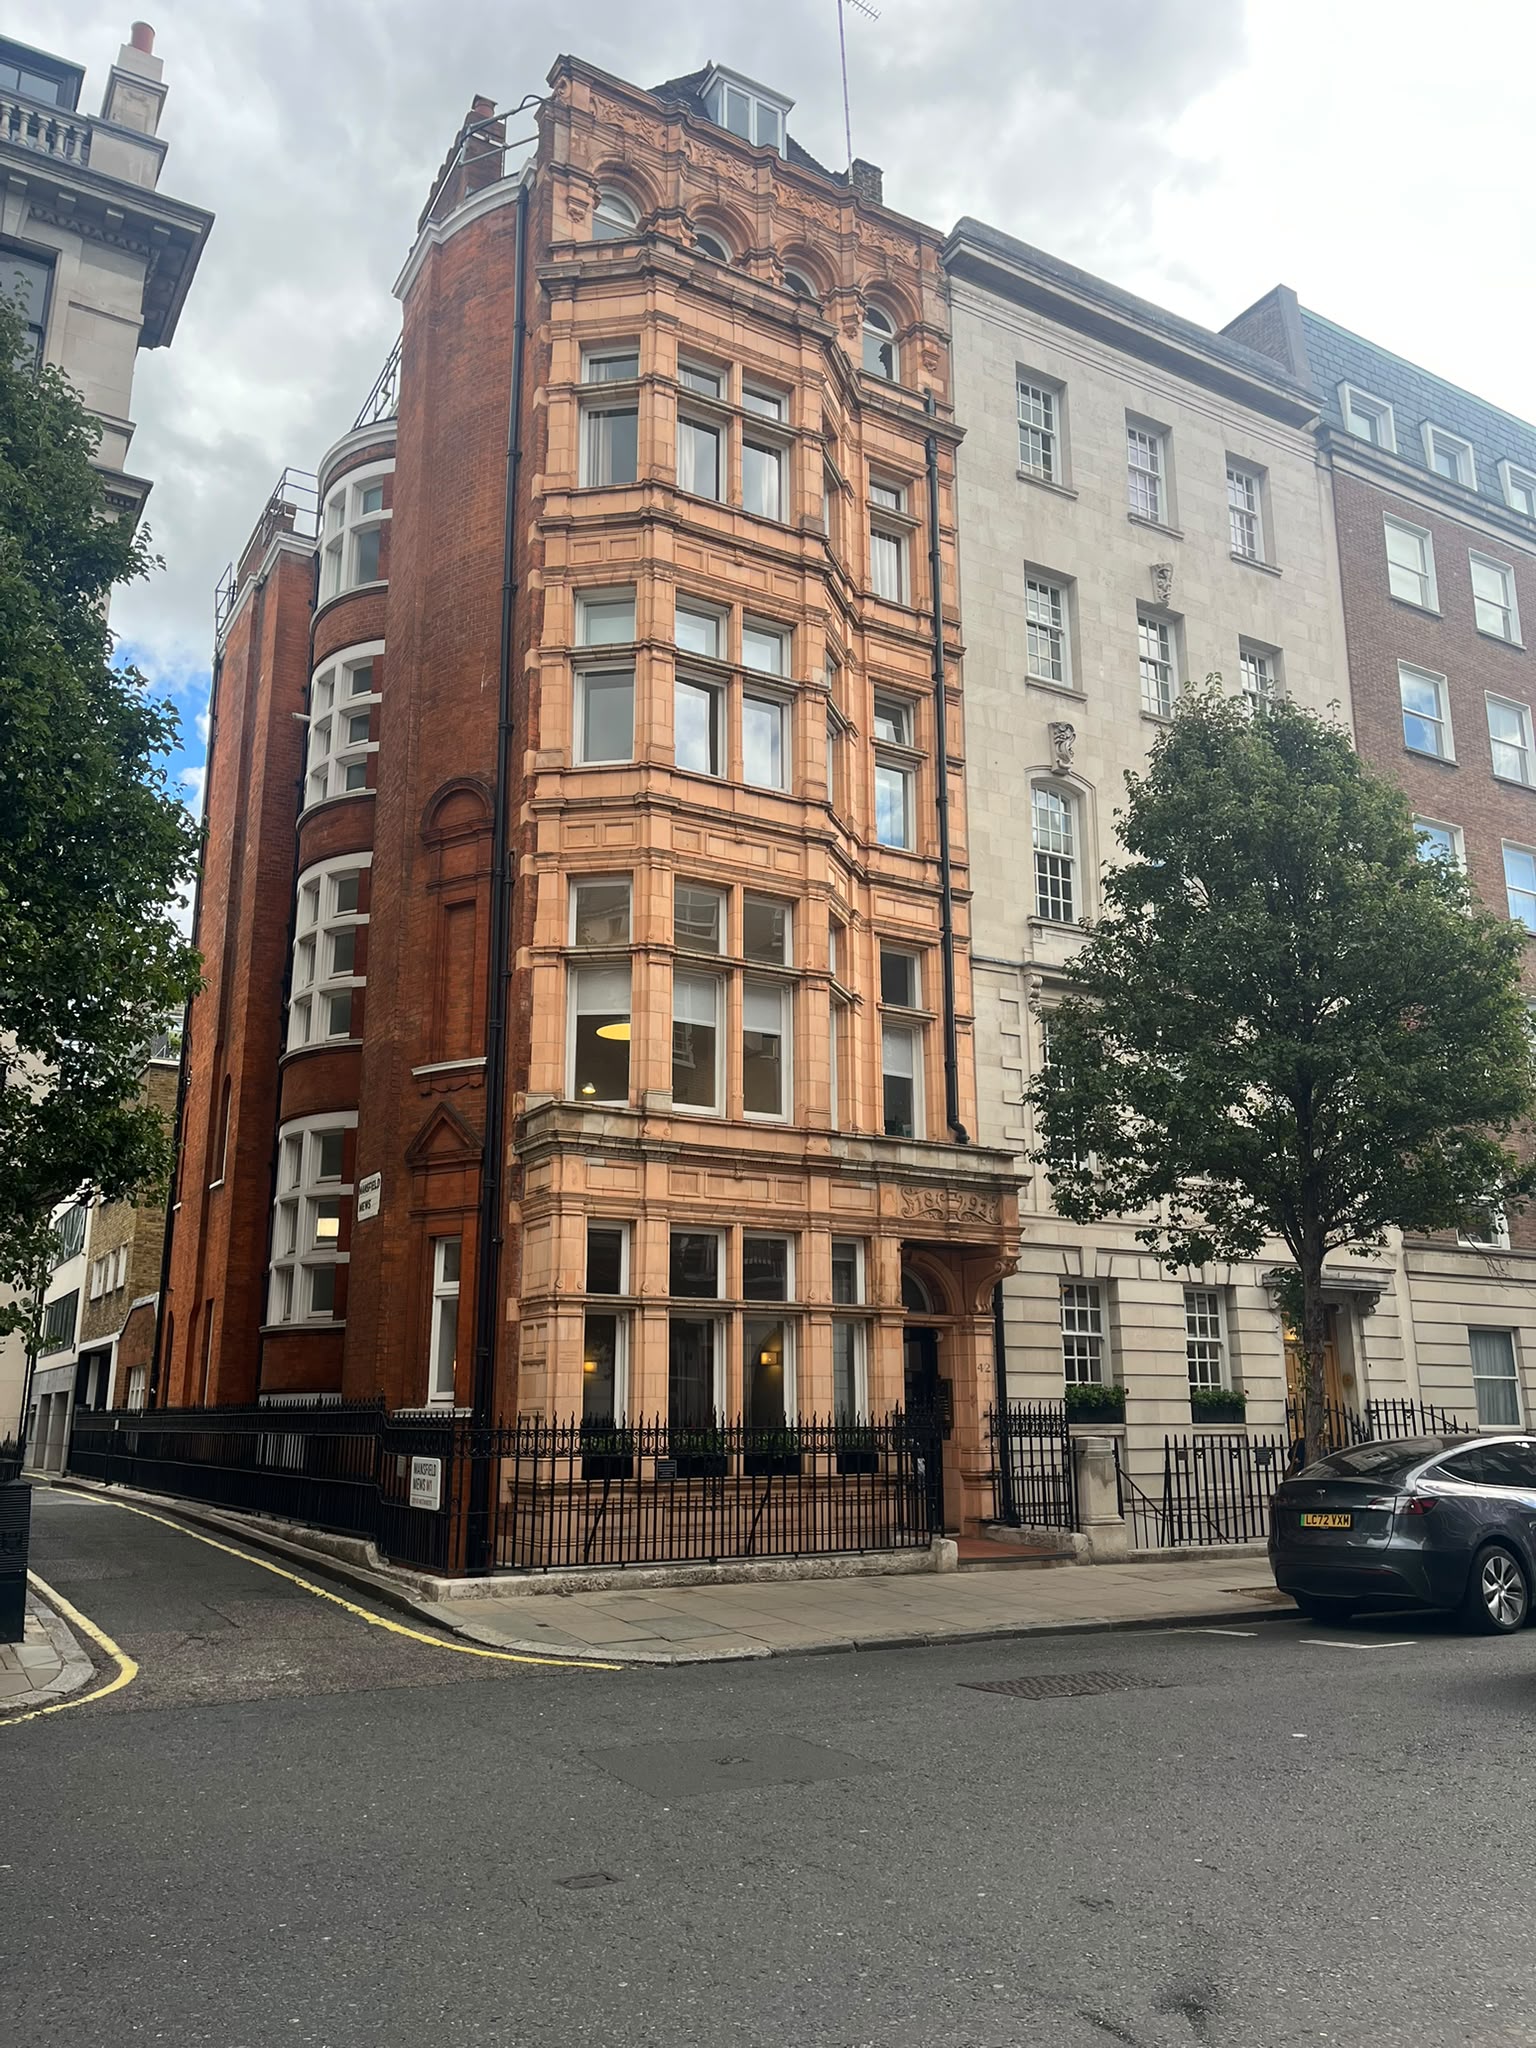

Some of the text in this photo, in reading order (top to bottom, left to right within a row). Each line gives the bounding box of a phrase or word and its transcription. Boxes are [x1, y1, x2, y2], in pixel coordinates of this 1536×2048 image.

[977, 1362, 991, 1374] 42
[413, 1462, 437, 1477] MANSFIELD
[412, 1478, 426, 1491] MEWS
[1305, 1514, 1329, 1525] LC72
